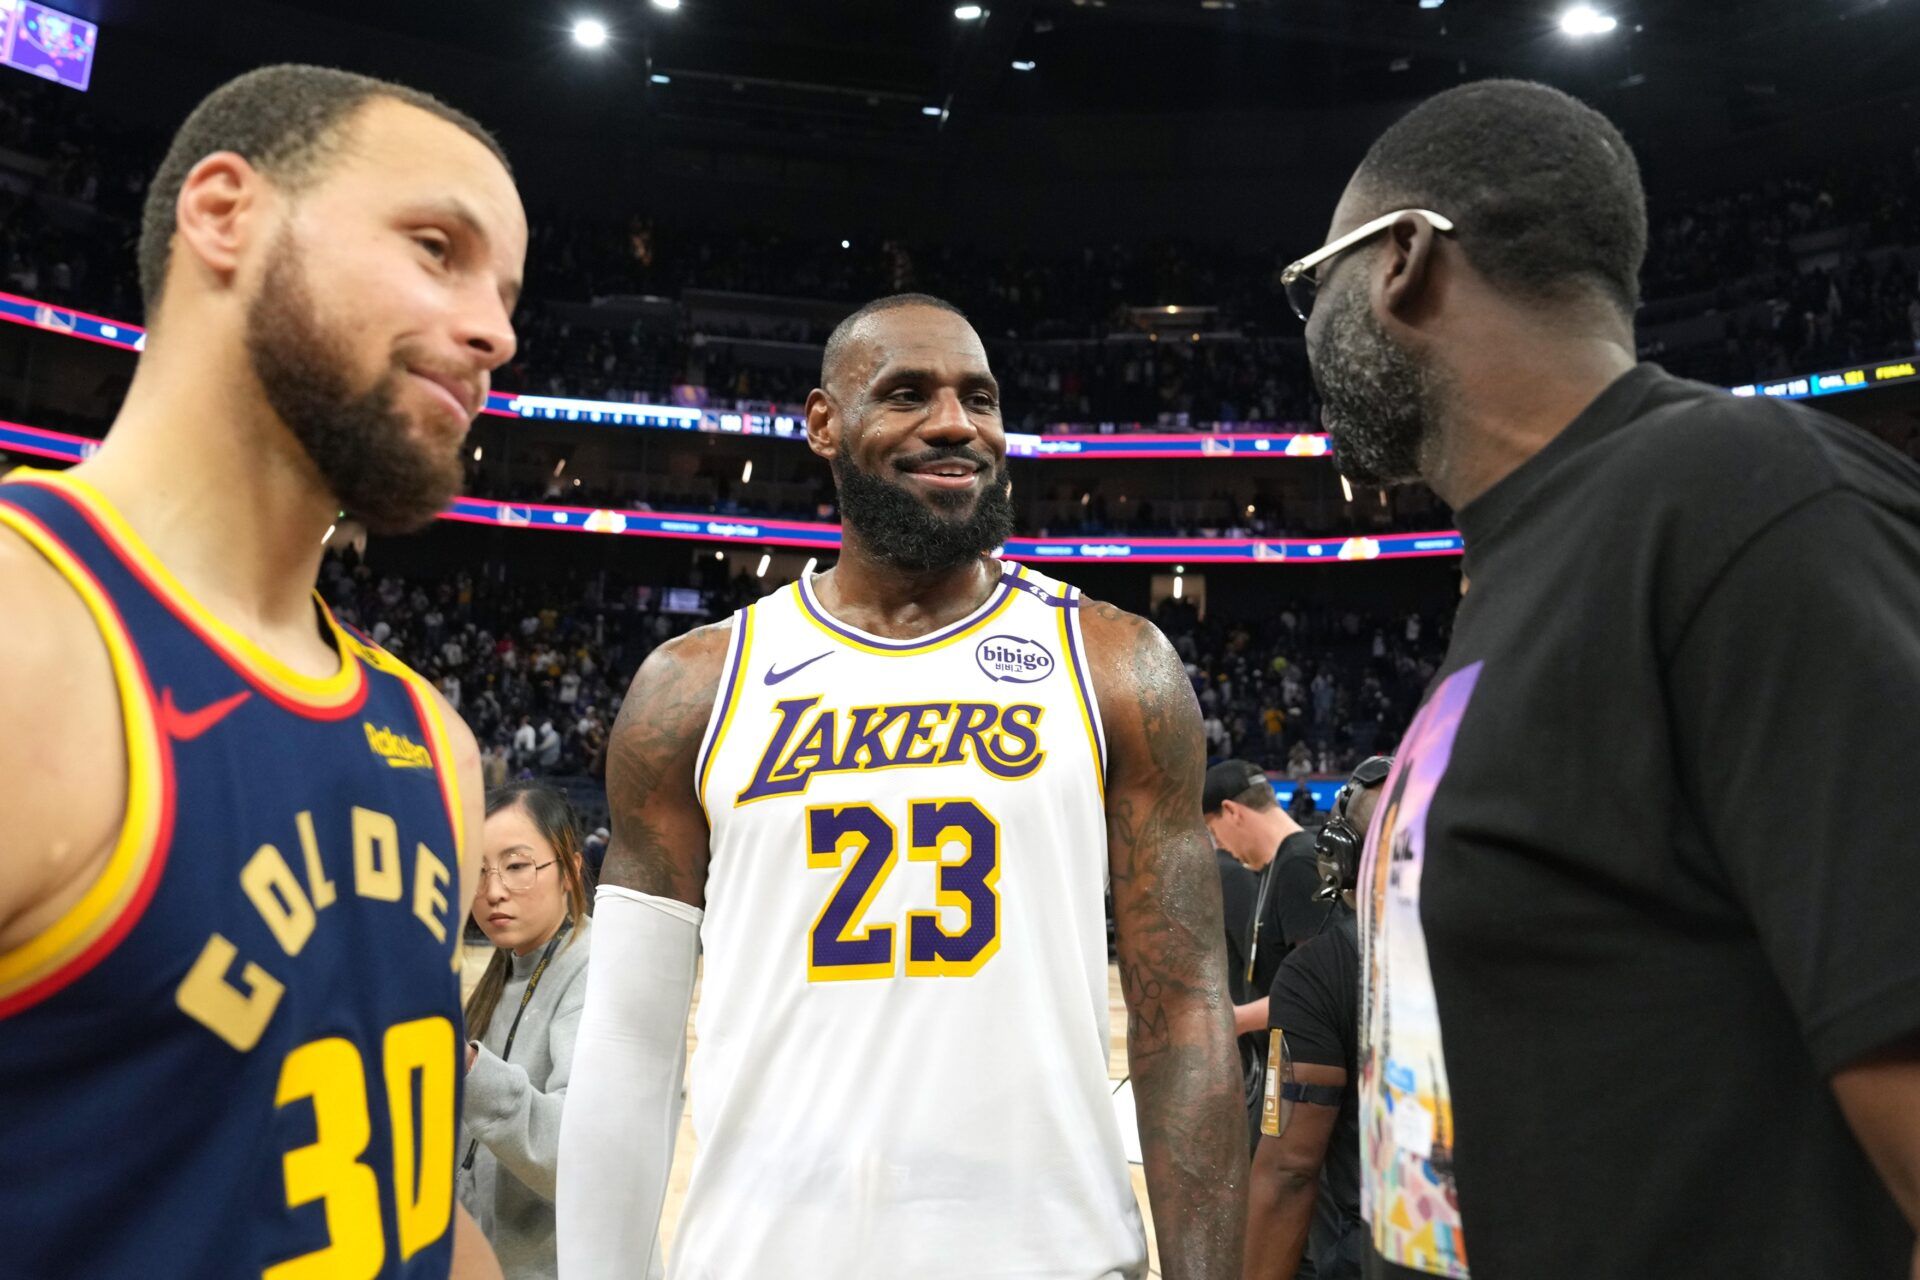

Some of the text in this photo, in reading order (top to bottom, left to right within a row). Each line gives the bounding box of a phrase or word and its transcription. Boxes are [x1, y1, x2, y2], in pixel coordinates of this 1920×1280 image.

[983, 646, 1049, 670] bibigo
[995, 663, 1023, 672] 비비고
[363, 721, 434, 769] Rakuten
[734, 693, 1047, 808] LAKERS
[175, 805, 463, 1053] GOLDE
[804, 797, 1001, 983] 23
[261, 1015, 456, 1280] 30
